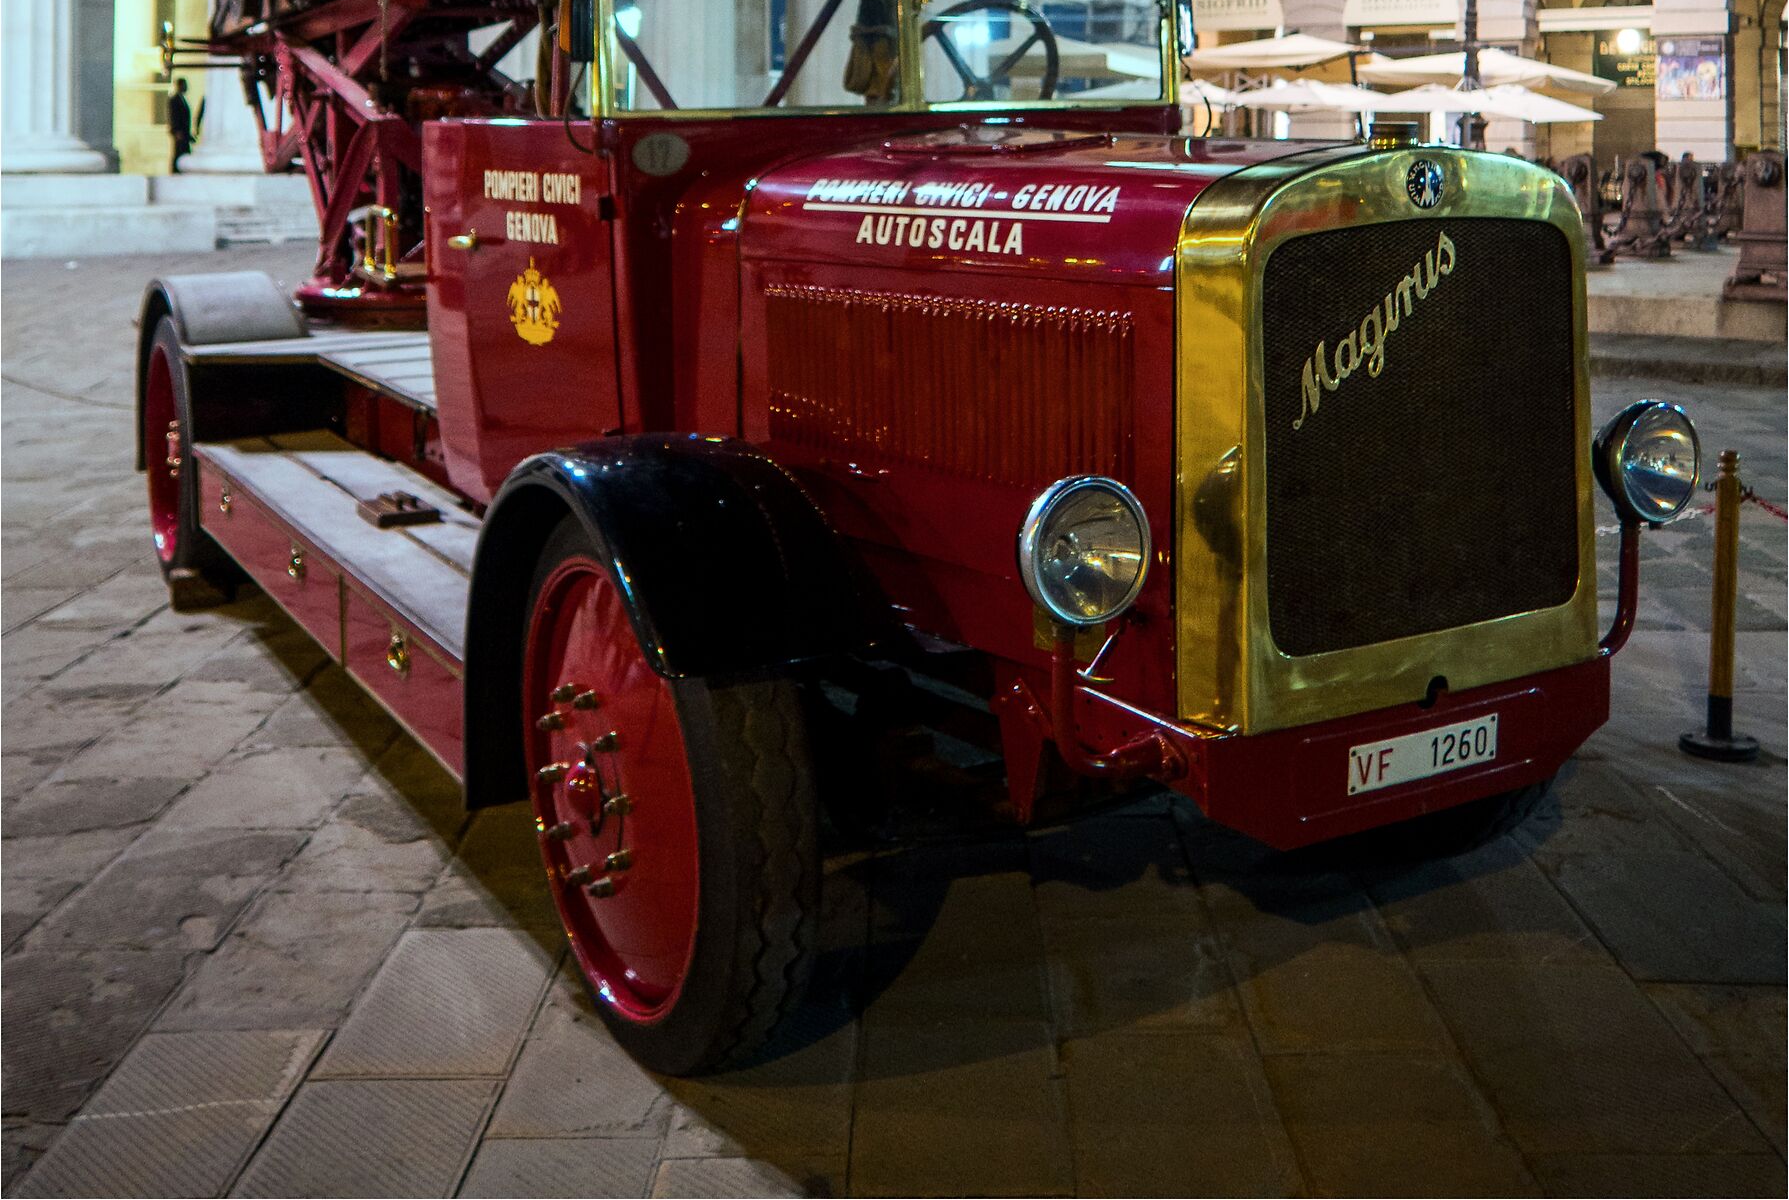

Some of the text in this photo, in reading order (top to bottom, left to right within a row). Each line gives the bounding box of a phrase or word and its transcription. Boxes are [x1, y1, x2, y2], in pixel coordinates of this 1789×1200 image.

[484, 169, 581, 205] POMPIERI CIVICI
[806, 178, 912, 204] POMPIERI
[915, 181, 993, 208] CIVICI
[1012, 183, 1121, 213] GENOVA
[506, 211, 558, 245] GENOVA
[856, 214, 1023, 255] AUTOSCALA
[1293, 231, 1455, 430] Magirus
[1357, 726, 1488, 785] VF 1260
